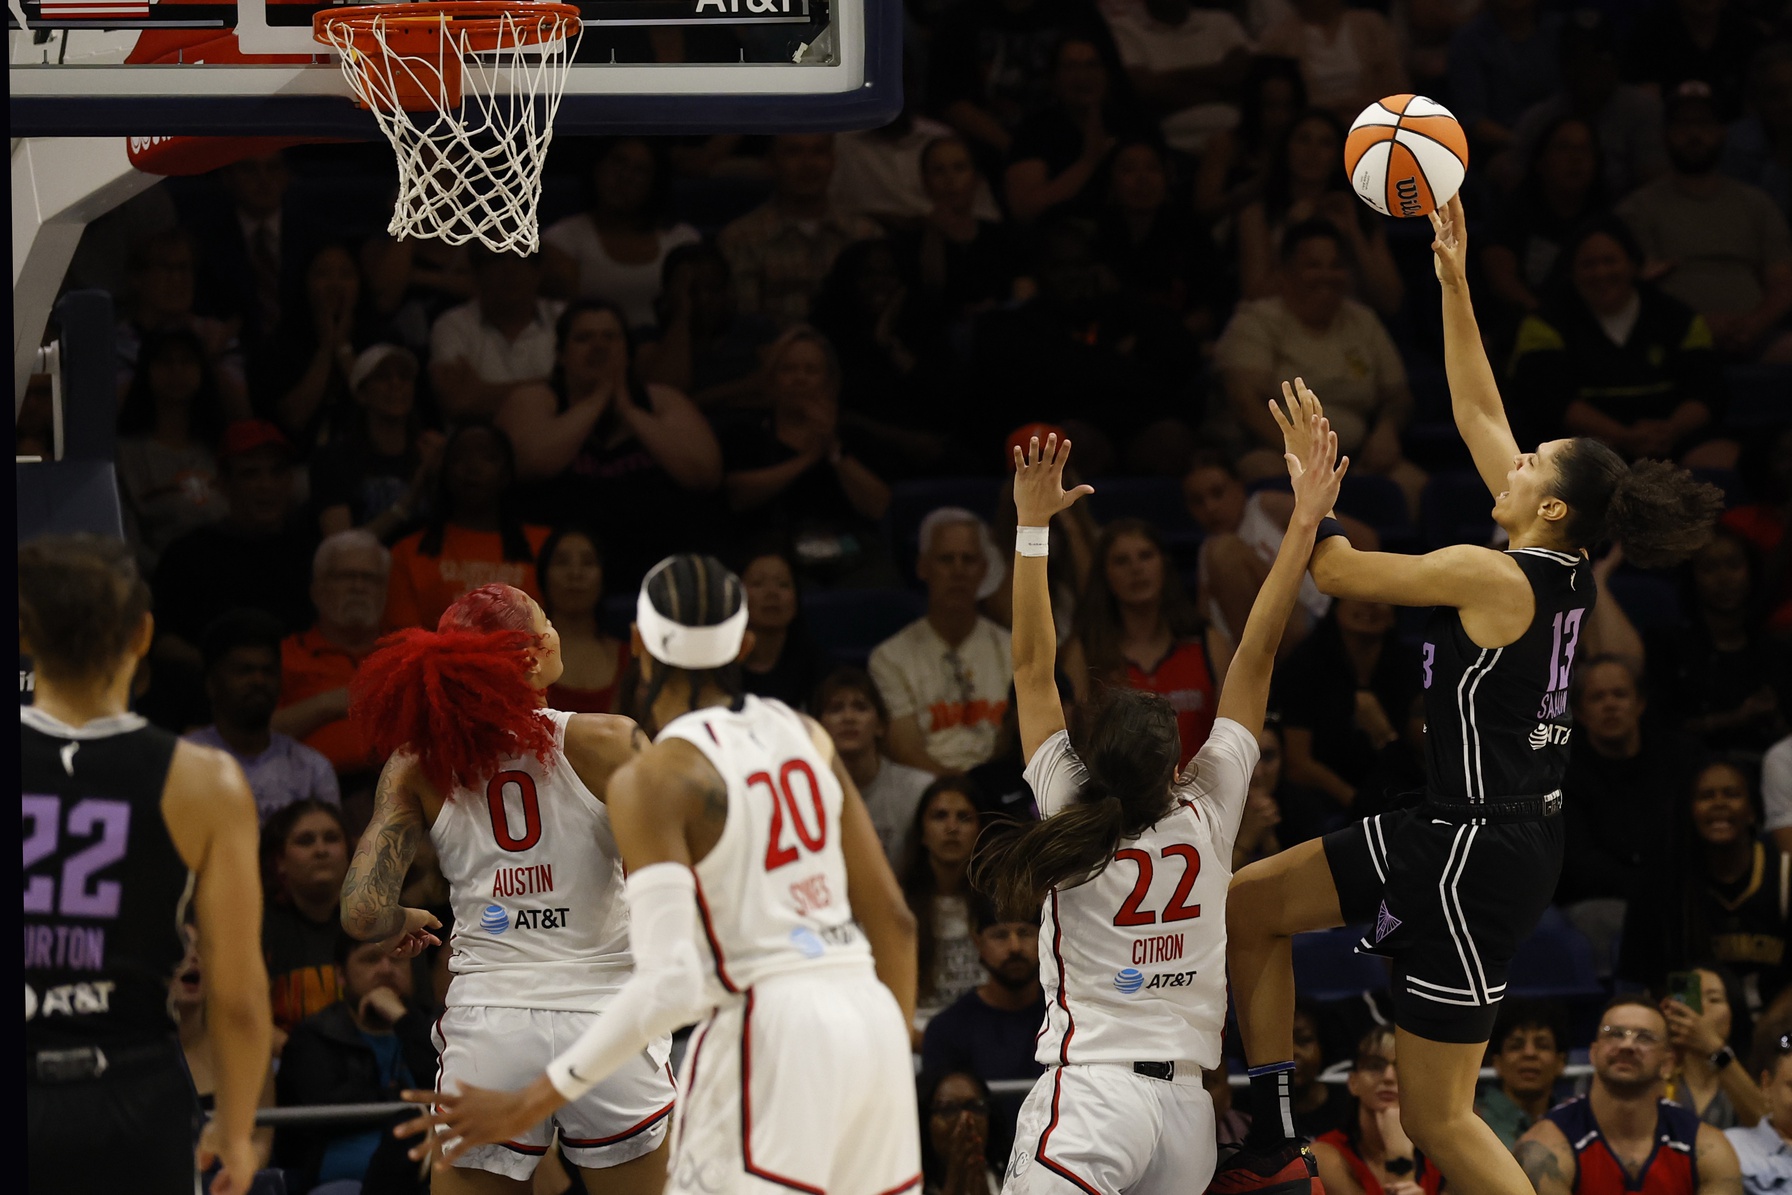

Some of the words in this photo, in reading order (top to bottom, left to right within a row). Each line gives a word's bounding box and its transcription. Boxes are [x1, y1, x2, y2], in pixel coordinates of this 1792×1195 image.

[1546, 607, 1586, 693] 13
[486, 769, 542, 852] 0
[746, 758, 827, 873] 20
[492, 863, 554, 898] AUSTIN
[1112, 843, 1201, 927] 22
[514, 907, 570, 930] AT&T
[24, 923, 105, 970] URTON
[1131, 932, 1185, 966] CITRON
[1145, 970, 1198, 990] AT&T
